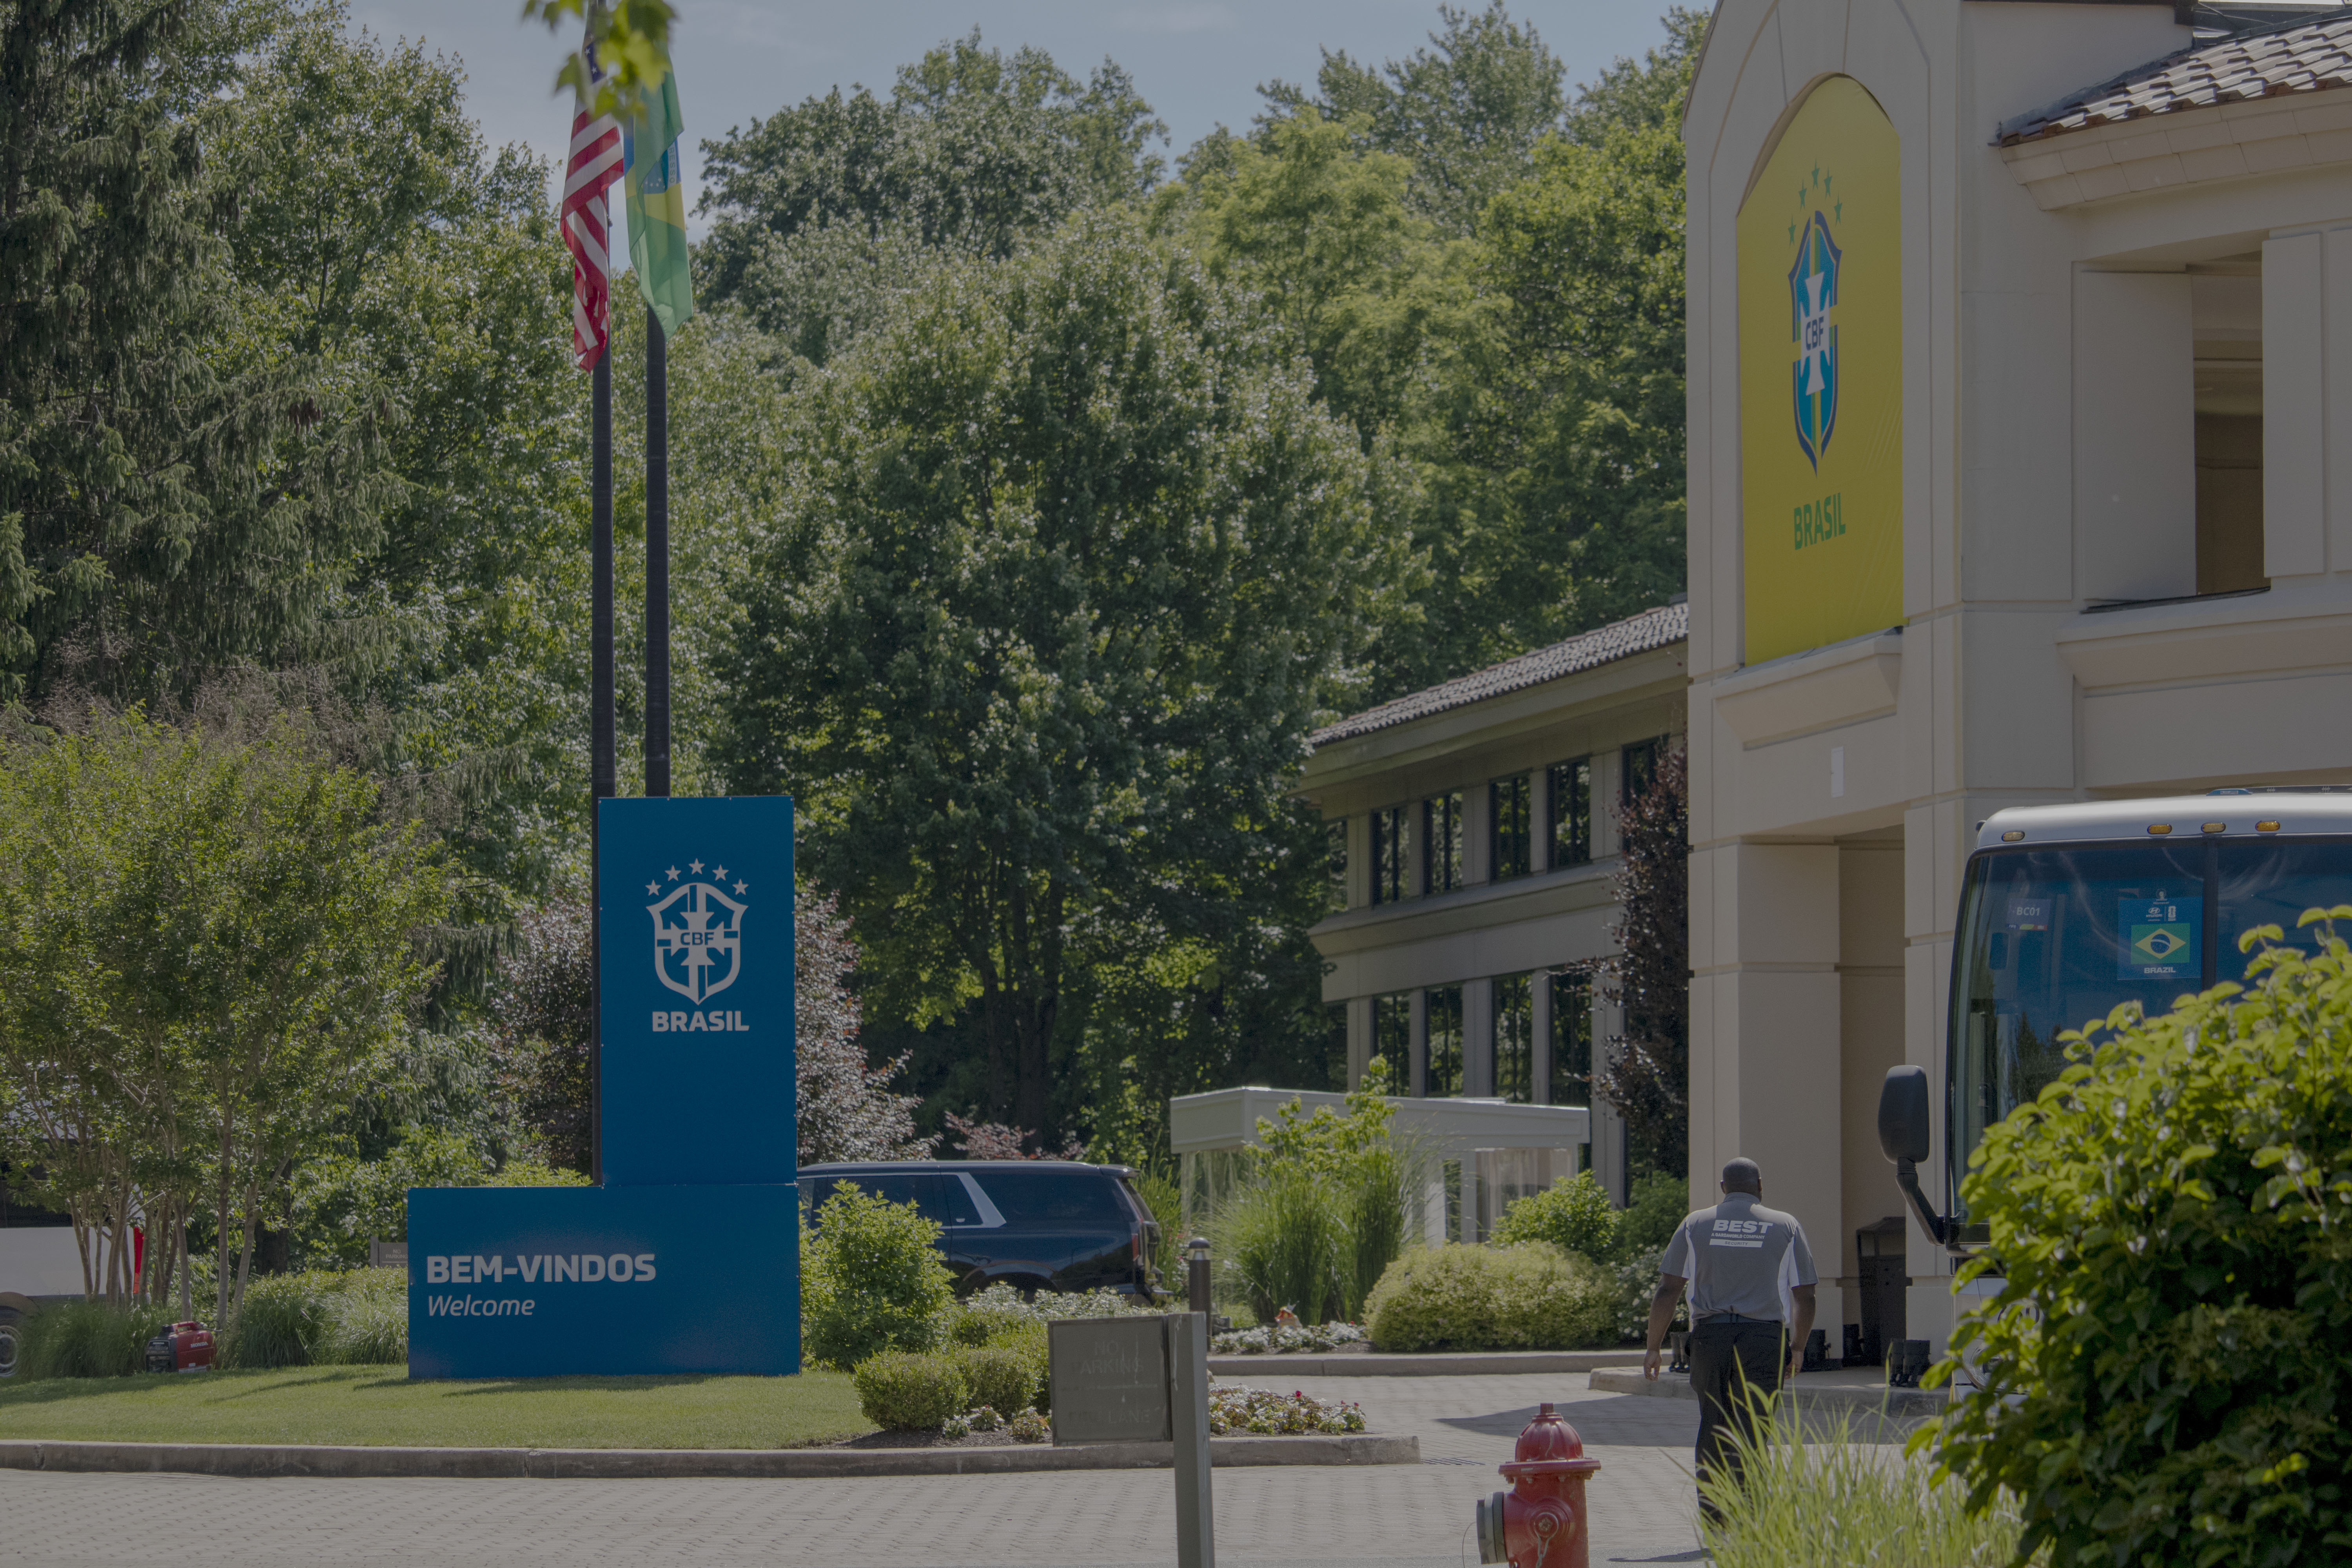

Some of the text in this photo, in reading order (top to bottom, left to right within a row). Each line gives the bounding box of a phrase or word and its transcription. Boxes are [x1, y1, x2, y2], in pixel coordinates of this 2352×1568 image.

[1805, 316, 1824, 351] CBF
[1793, 492, 1846, 550] BRASIL
[2016, 907, 2040, 916] BC01
[680, 932, 715, 945] CBF
[652, 1011, 750, 1032] BRASIL
[1713, 1220, 1773, 1234] BEST
[426, 1253, 656, 1283] BEM-VINDOS
[428, 1294, 535, 1316] Welcome
[1094, 1339, 1119, 1356] NO
